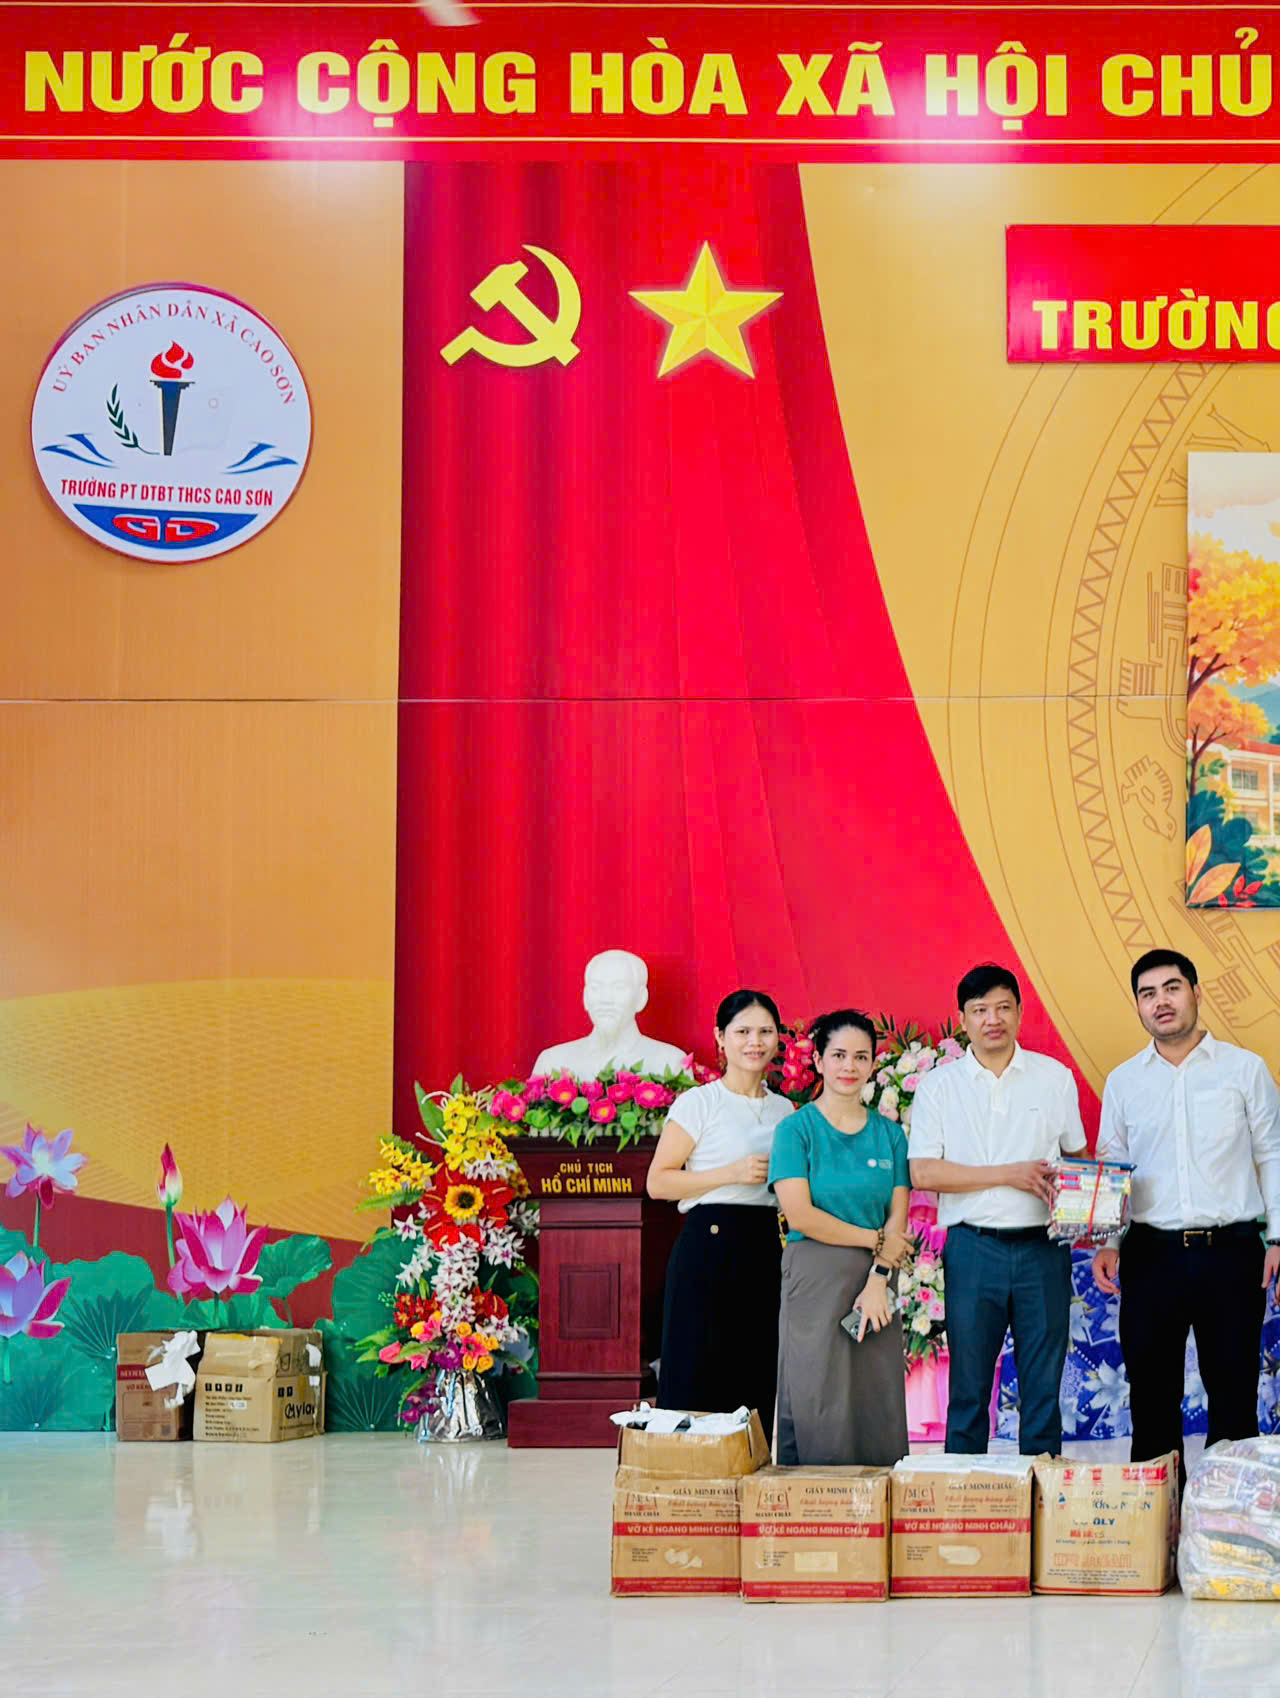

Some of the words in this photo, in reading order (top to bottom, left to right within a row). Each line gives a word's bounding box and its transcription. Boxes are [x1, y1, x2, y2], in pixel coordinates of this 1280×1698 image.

[24, 32, 264, 114] NƯỚC
[297, 38, 537, 127] CỘNG
[570, 37, 748, 115] HÒA
[776, 41, 894, 116] XÃ
[925, 41, 1067, 130] HỘI
[1101, 27, 1272, 117] CHỦ
[70, 328, 106, 366] BAN
[107, 303, 162, 337] NHÂN
[168, 300, 209, 321] DÂN
[240, 328, 275, 365] CAO
[60, 477, 117, 499] TRƯỜNG
[120, 483, 137, 500] PT
[140, 484, 175, 501] DTBT
[178, 486, 212, 503] THCS
[215, 488, 242, 505] CAO
[245, 489, 273, 506] SƠN
[559, 1158, 582, 1174] CHỦ
[587, 1162, 614, 1176] TỊCH
[541, 1173, 563, 1193] HỒ
[566, 1174, 591, 1193] CHÍ
[593, 1177, 633, 1193] MINH
